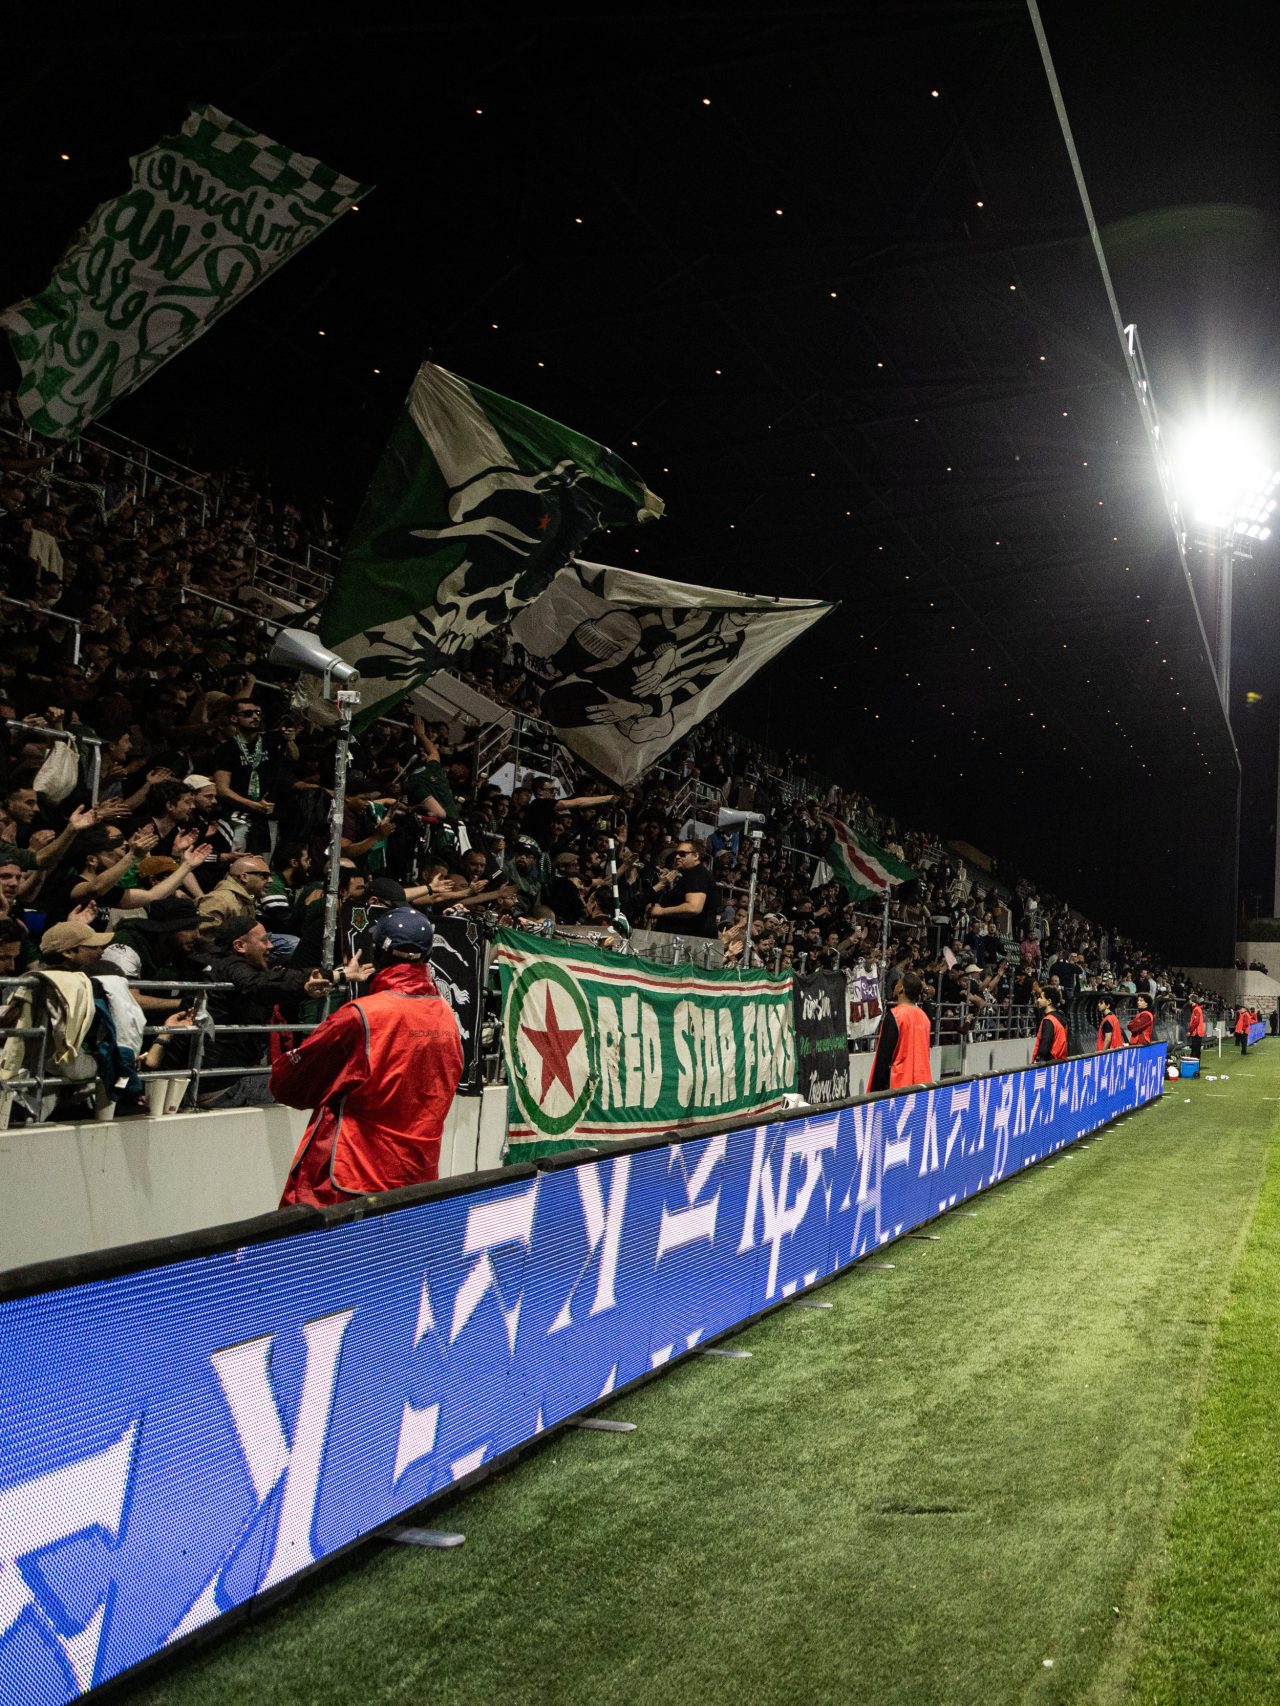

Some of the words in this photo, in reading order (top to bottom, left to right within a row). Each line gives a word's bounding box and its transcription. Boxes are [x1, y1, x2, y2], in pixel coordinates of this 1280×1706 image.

[597, 993, 662, 1110] RED
[673, 999, 737, 1108] STAR
[743, 1000, 796, 1096] FANS
